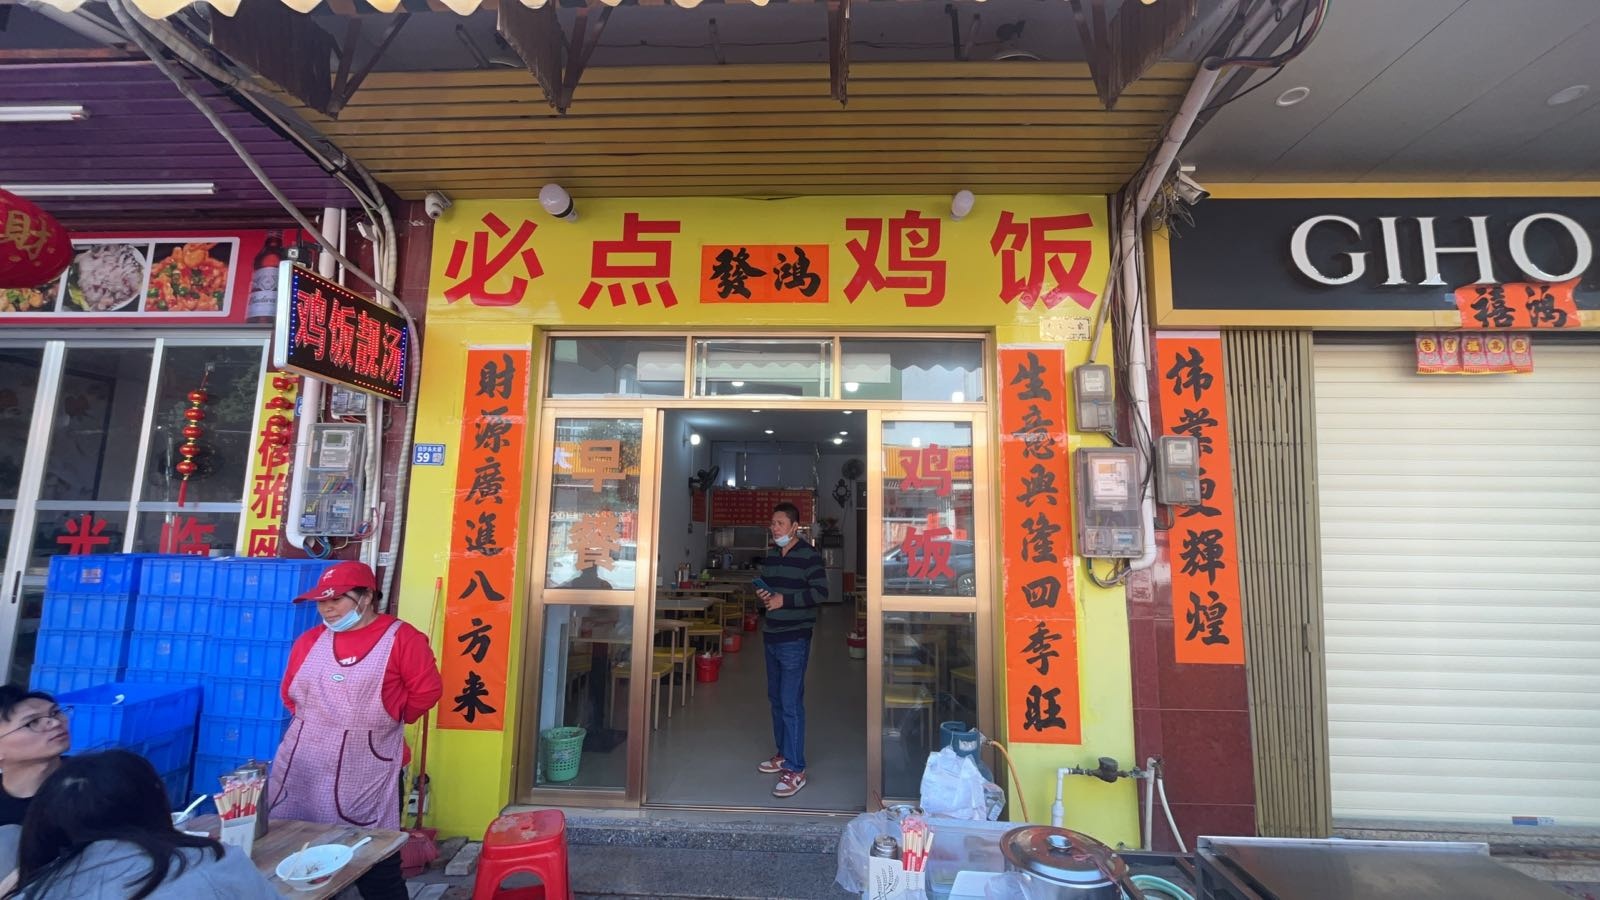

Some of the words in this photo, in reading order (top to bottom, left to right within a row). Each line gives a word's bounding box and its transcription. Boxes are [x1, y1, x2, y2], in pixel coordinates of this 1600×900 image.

[1291, 212, 1592, 285] GIHO
[295, 287, 403, 386] 鸡饭靓汤
[416, 452, 430, 462] 59
[899, 443, 956, 581] 鸡饭
